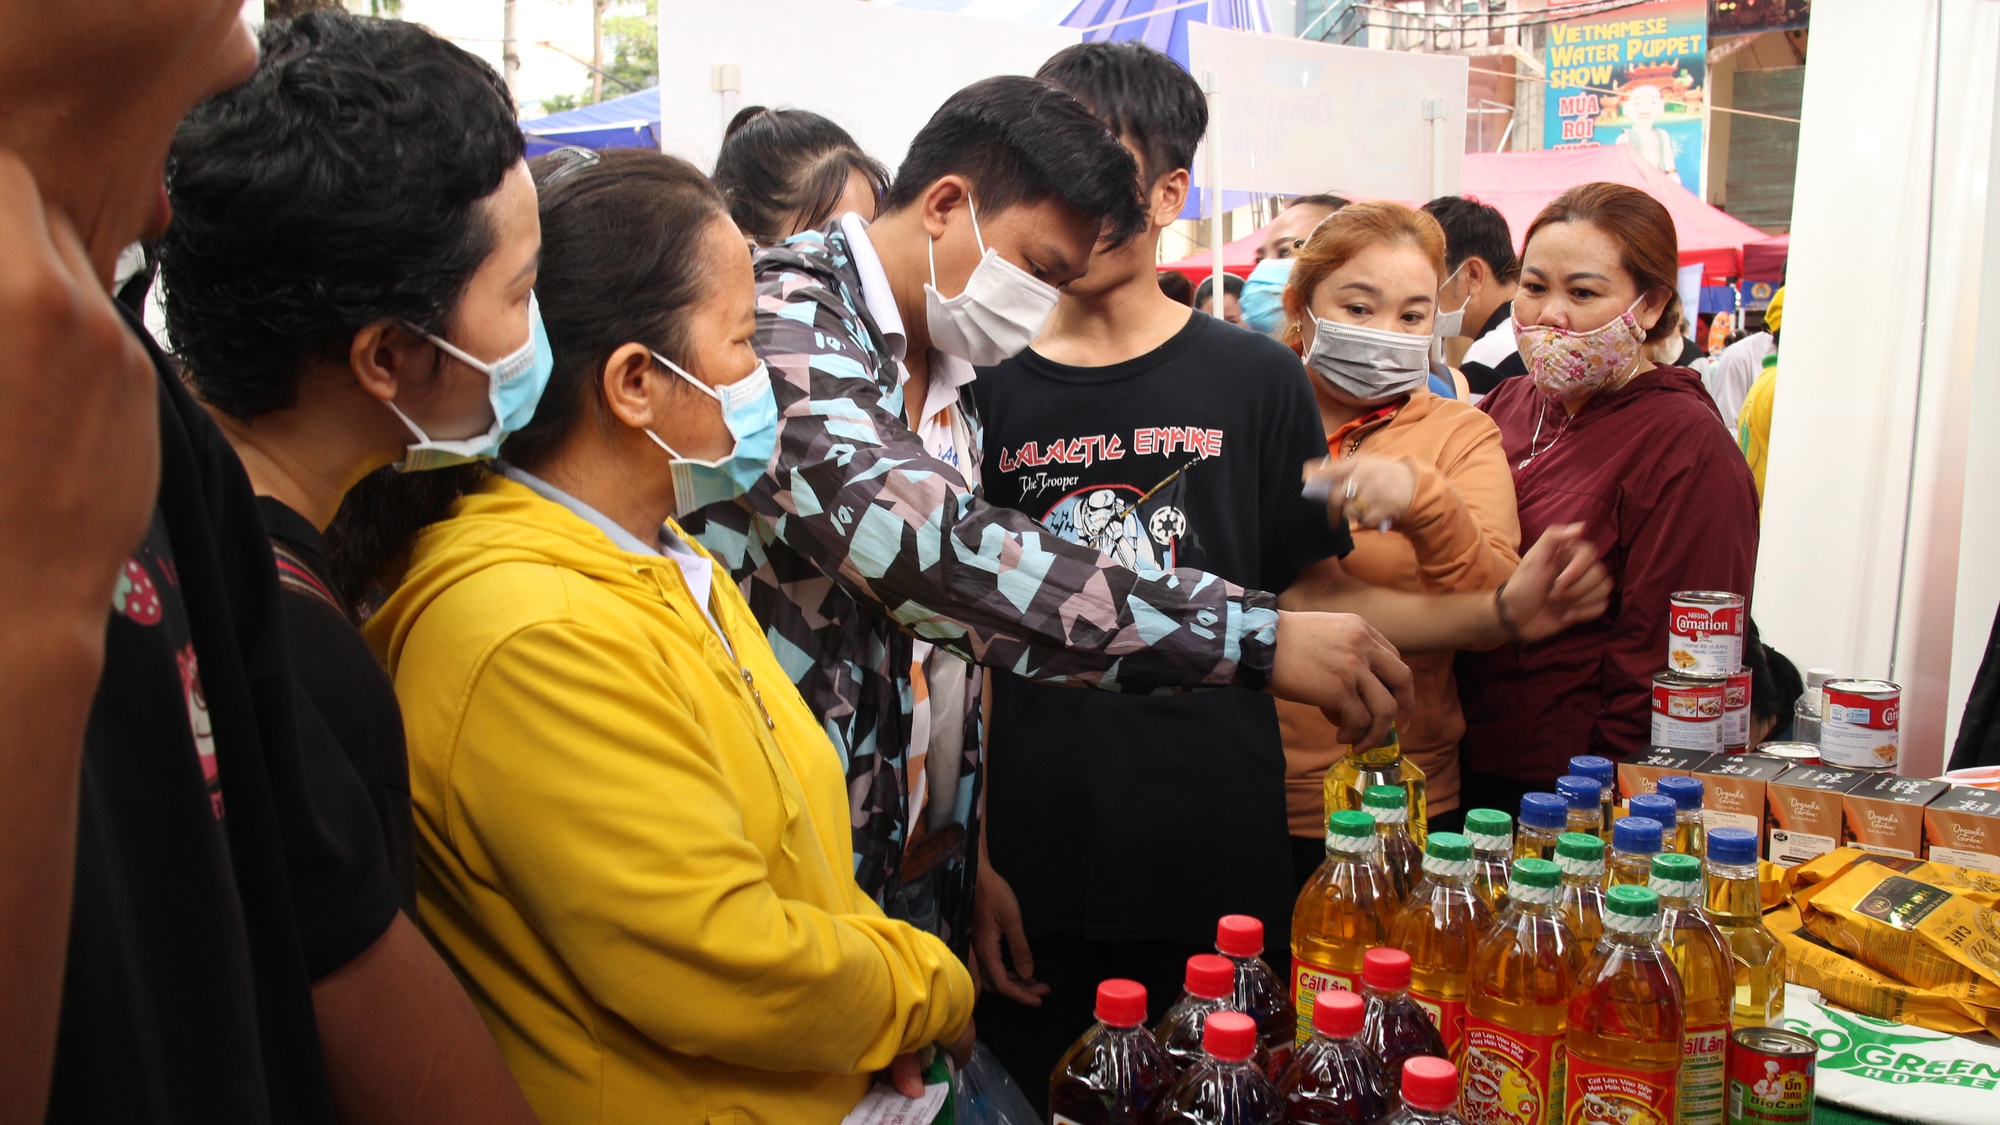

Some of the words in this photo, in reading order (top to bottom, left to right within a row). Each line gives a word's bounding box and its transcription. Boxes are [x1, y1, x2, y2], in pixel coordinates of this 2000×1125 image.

[1550, 17, 1668, 45] VIETNAMESE
[1550, 43, 1620, 68] WATER
[1626, 35, 1702, 61] PUPPET
[1550, 64, 1613, 90] SHOW
[1559, 92, 1599, 117] MÚA
[999, 433, 1126, 473] GALACTIC
[1134, 426, 1224, 461] EMPIRE
[1019, 474, 1037, 502] The
[1036, 472, 1079, 498] Trooper
[1676, 615, 1728, 633] Carnation
[1715, 787, 1745, 801] Organika
[1719, 797, 1741, 806] Garden
[1790, 798, 1821, 812] Organika
[1794, 807, 1817, 818] Garden
[1867, 810, 1899, 824] Organika
[1871, 820, 1895, 831] Garden
[1952, 823, 1986, 838] Organika
[1957, 833, 1981, 844] Garden
[1299, 972, 1321, 991] Cái
[1699, 1036, 1724, 1053] Lân
[1855, 1043, 2000, 1079] GREEN
[1750, 1096, 1803, 1110] BigCan
